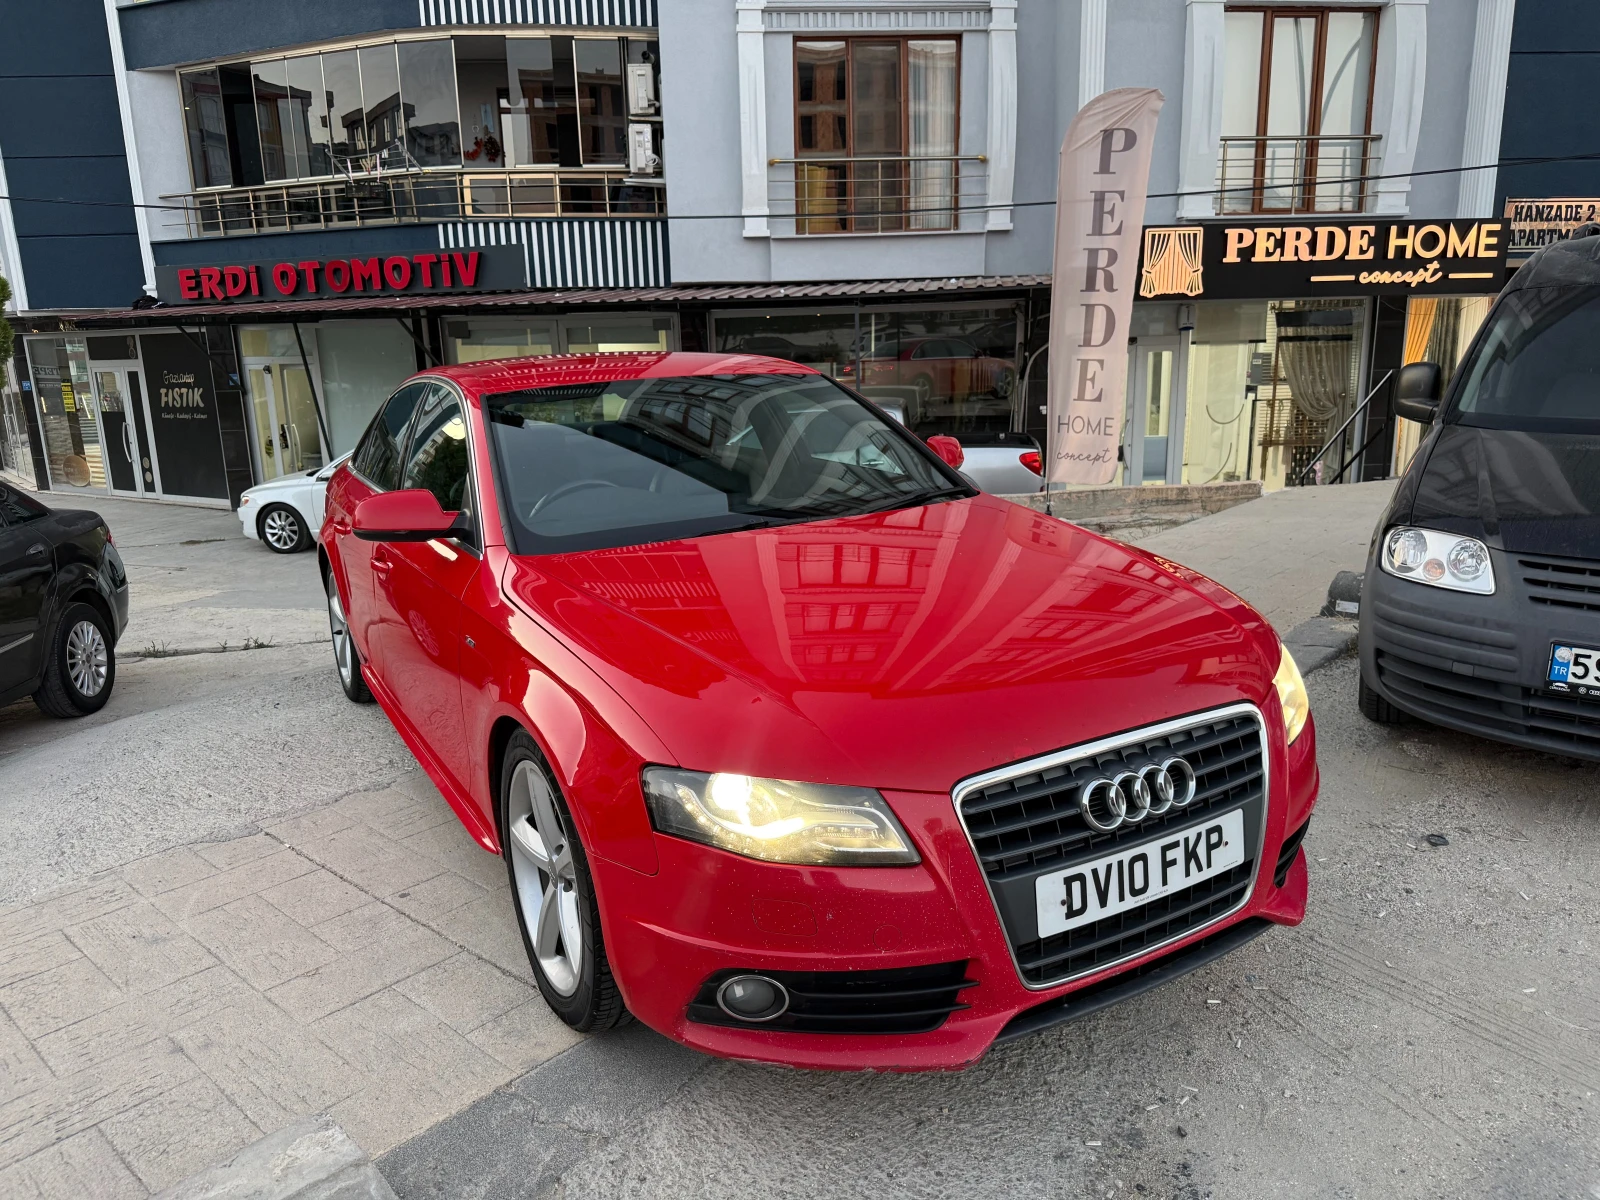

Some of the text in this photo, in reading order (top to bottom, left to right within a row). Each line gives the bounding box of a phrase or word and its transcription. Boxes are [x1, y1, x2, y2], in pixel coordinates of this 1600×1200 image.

[1513, 204, 1596, 222] HANZADE 2
[1222, 221, 1502, 263] PERDE HOME
[1509, 228, 1578, 247] APARTM
[1073, 127, 1138, 402] PERDE
[1358, 260, 1443, 288] concept
[1057, 414, 1115, 436] HOME
[1056, 447, 1112, 466] concept
[1553, 665, 1568, 676] TR
[1063, 824, 1223, 920] DV10 FKP
